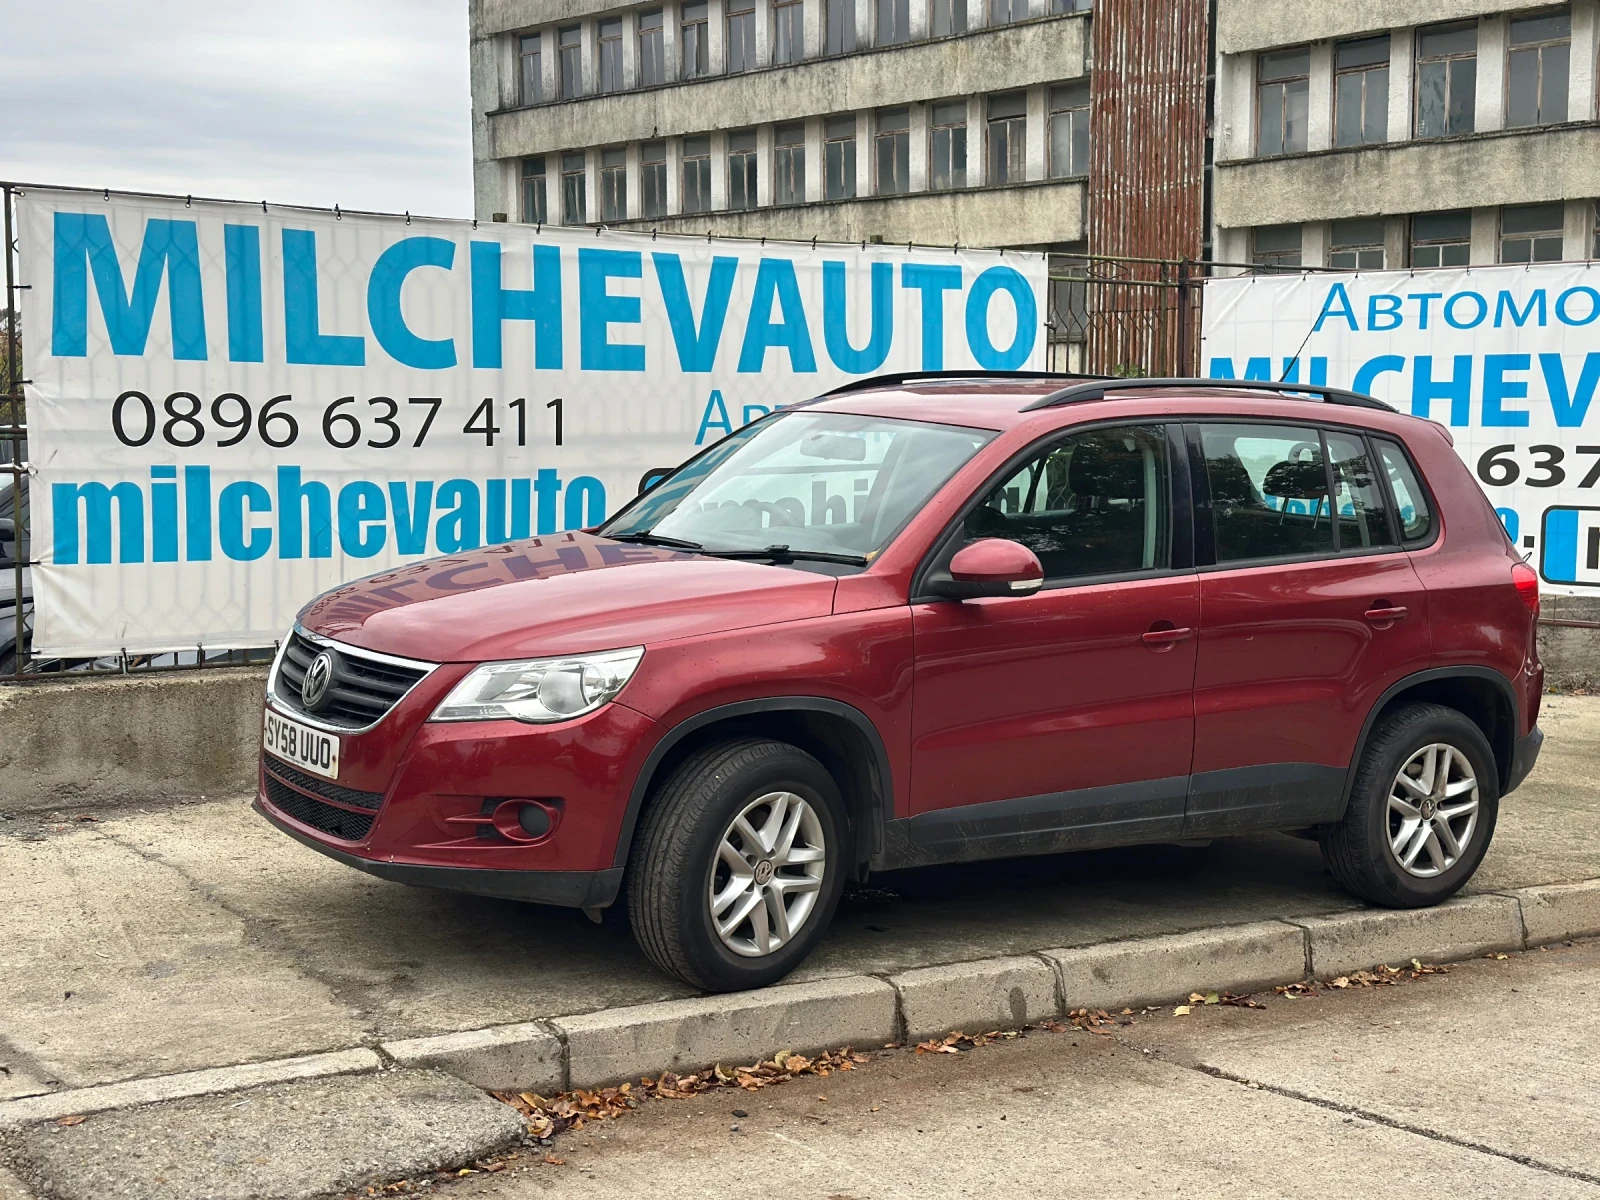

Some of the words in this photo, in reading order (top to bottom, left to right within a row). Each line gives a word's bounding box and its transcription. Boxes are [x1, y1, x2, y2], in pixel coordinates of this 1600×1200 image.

[51, 211, 1037, 375] MILCHEVAUTO
[112, 390, 299, 447] 0896
[321, 396, 442, 449] 637
[462, 397, 563, 447] 411
[52, 464, 606, 565] milchevauto
[267, 715, 297, 757] SY58
